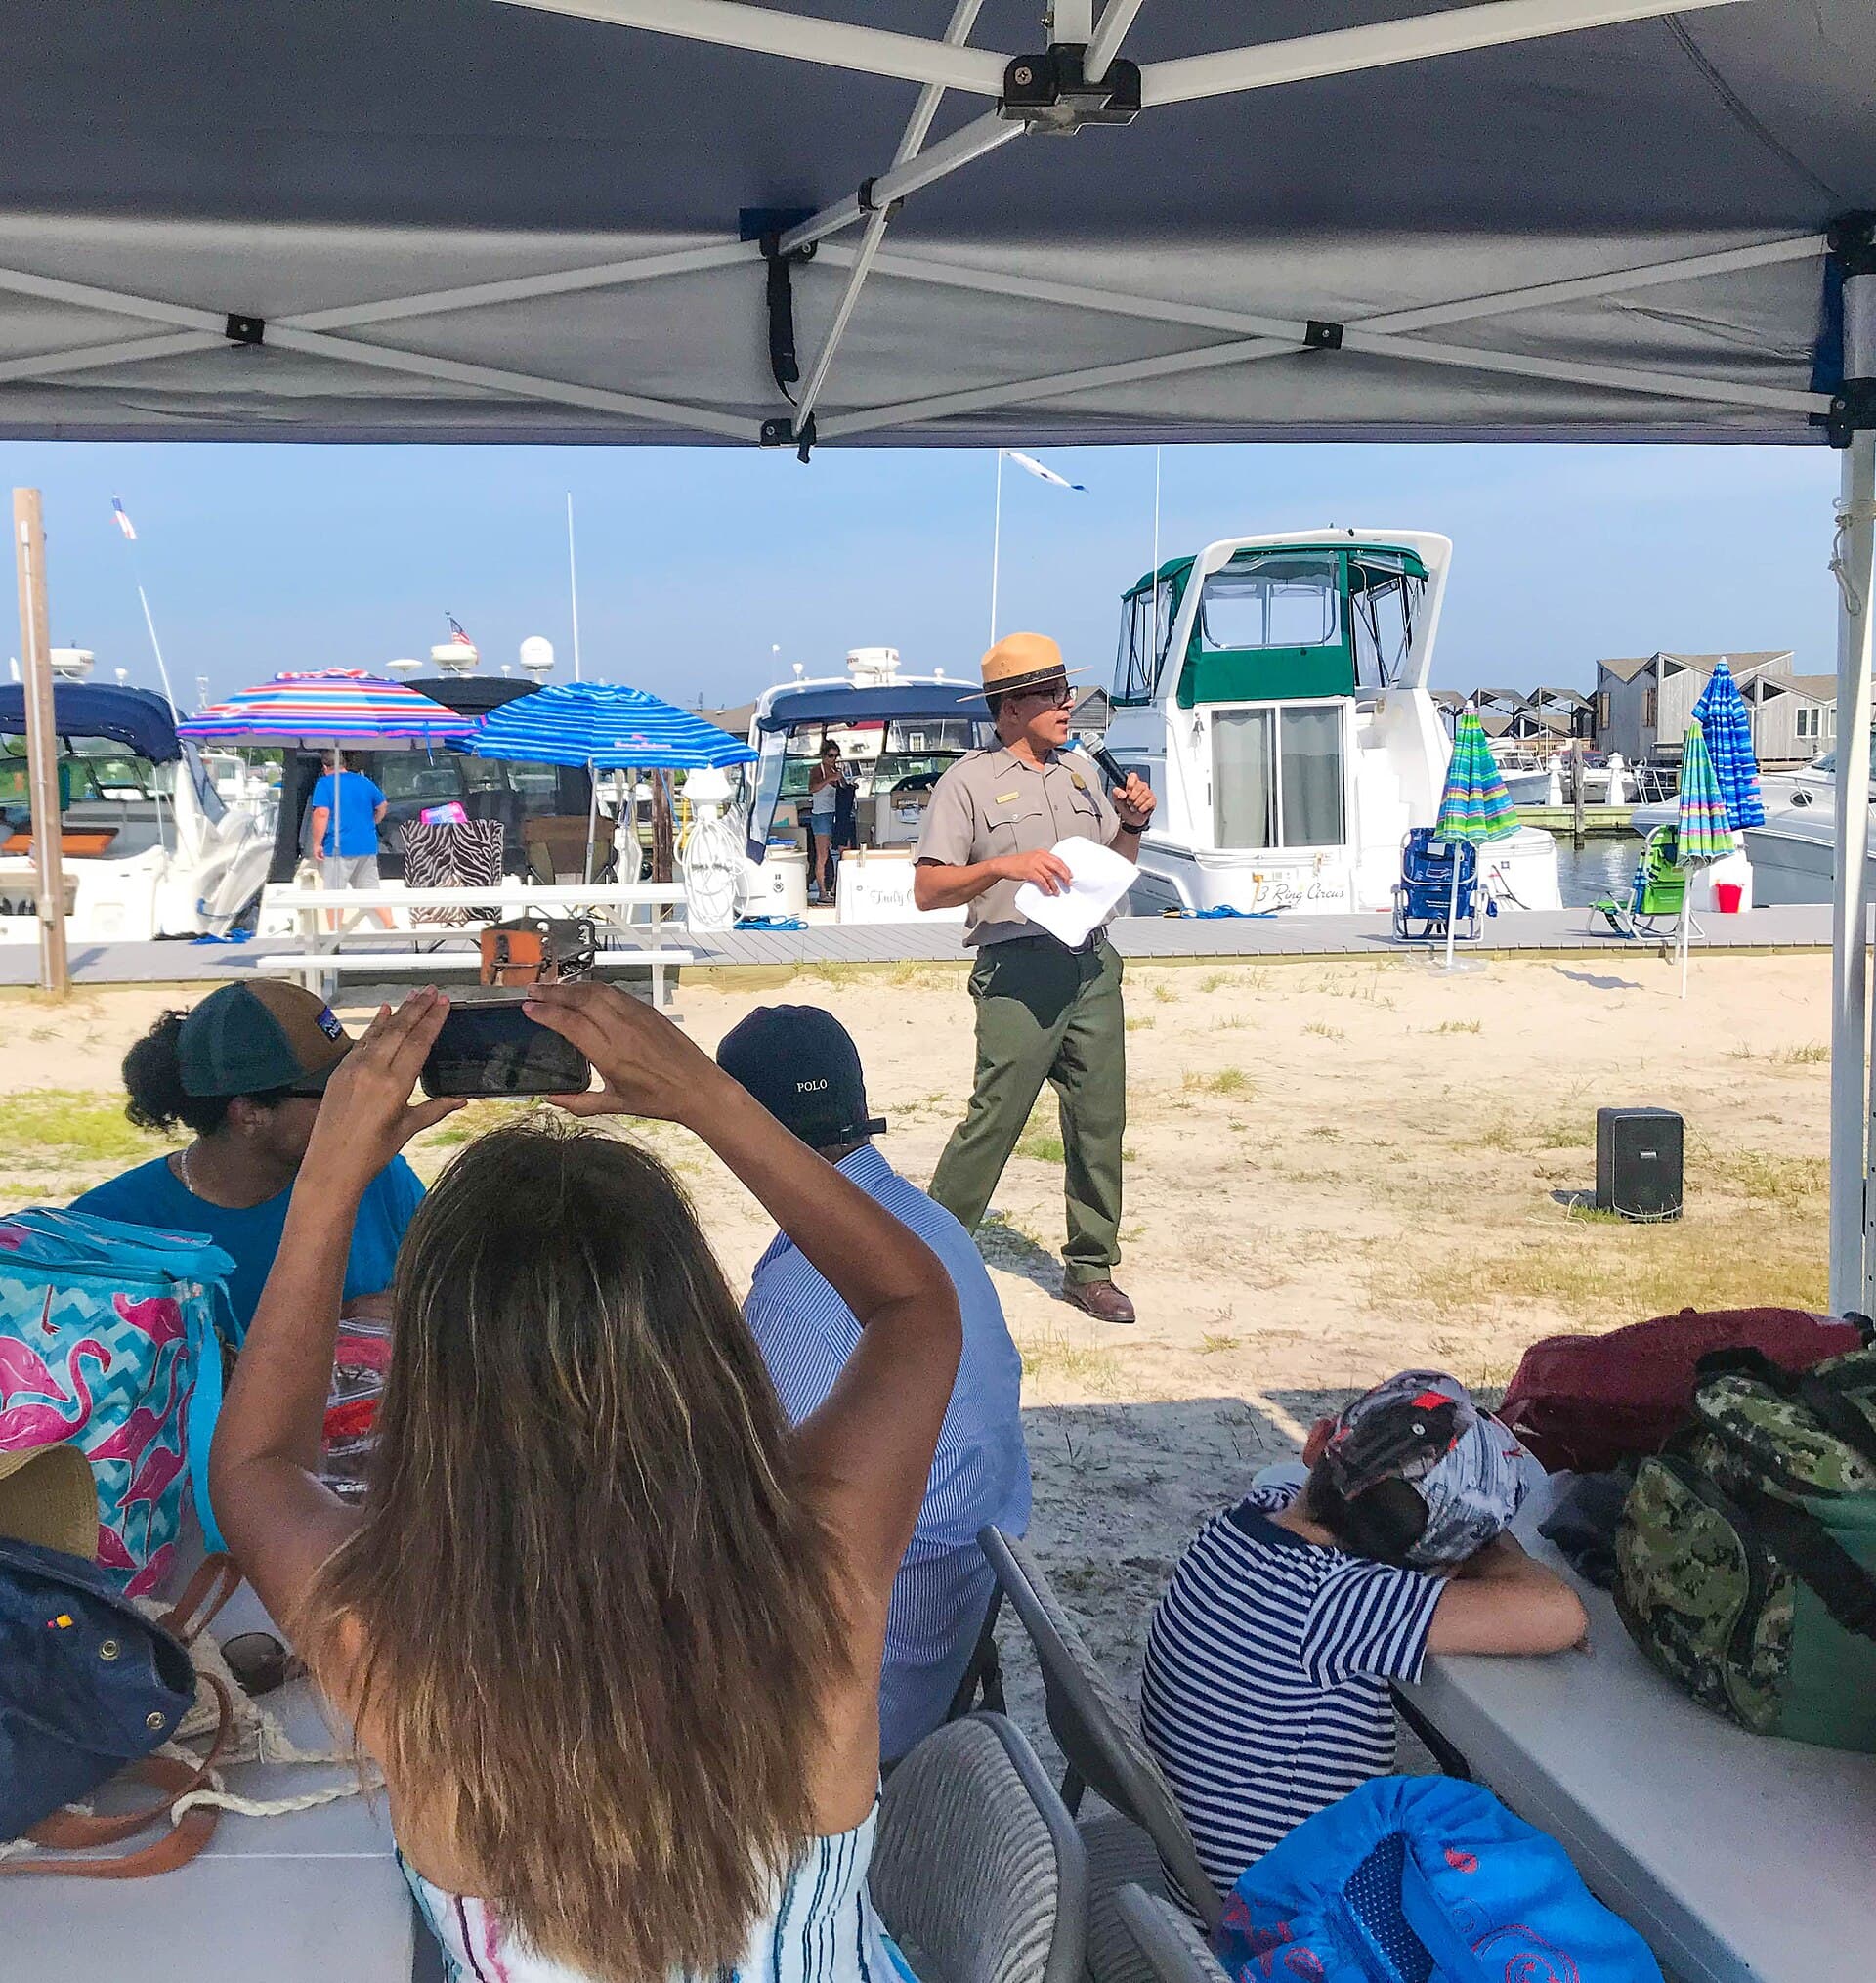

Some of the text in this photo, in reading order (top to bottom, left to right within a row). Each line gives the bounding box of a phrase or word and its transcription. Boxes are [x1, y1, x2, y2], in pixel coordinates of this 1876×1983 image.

[1257, 883, 1344, 904] 3 Ring Circus
[796, 1078, 828, 1093] POLO
